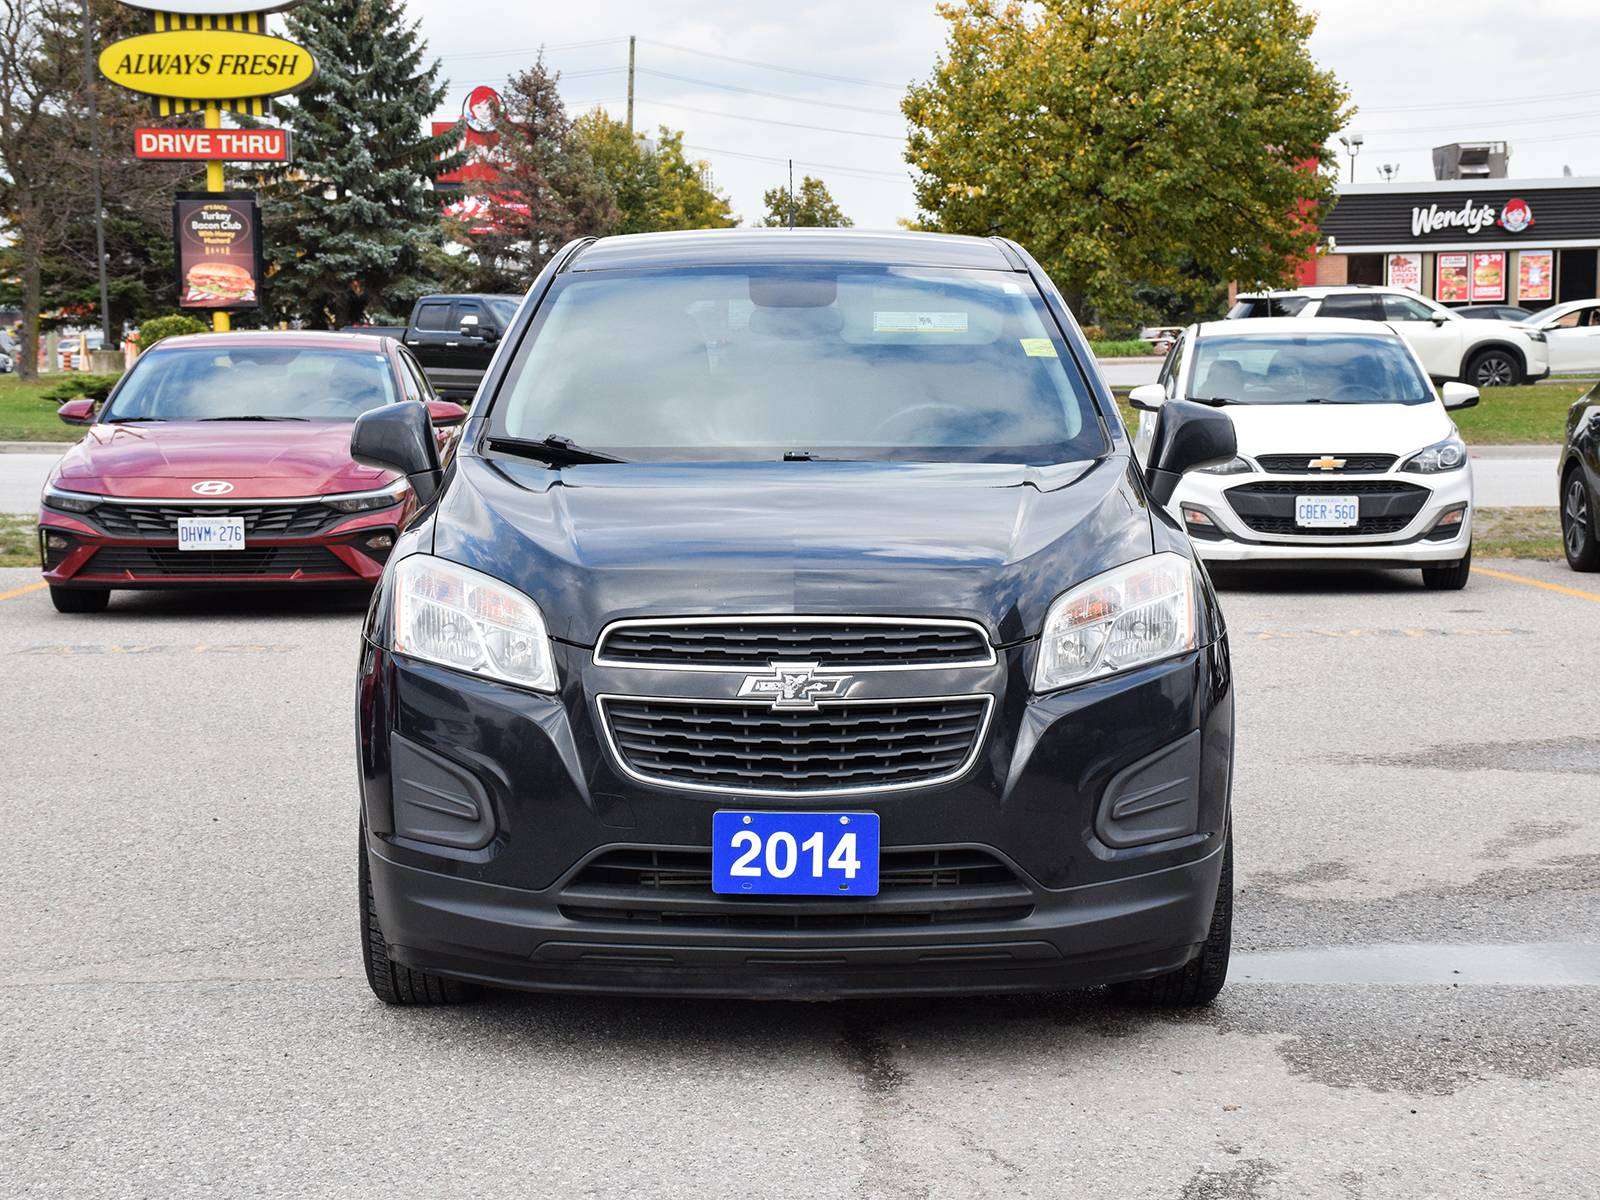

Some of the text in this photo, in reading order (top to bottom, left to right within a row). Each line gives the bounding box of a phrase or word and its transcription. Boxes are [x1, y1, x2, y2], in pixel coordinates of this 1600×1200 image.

[115, 53, 299, 76] ALWAYS FRESH
[140, 133, 281, 154] DRIVE THRU
[191, 221, 242, 230] Bacon Club
[201, 211, 231, 222] Turkey
[1411, 199, 1495, 236] Wendy's
[1299, 504, 1356, 520] CBER 560
[181, 526, 242, 542] DHVM 276
[729, 830, 861, 879] 2014
